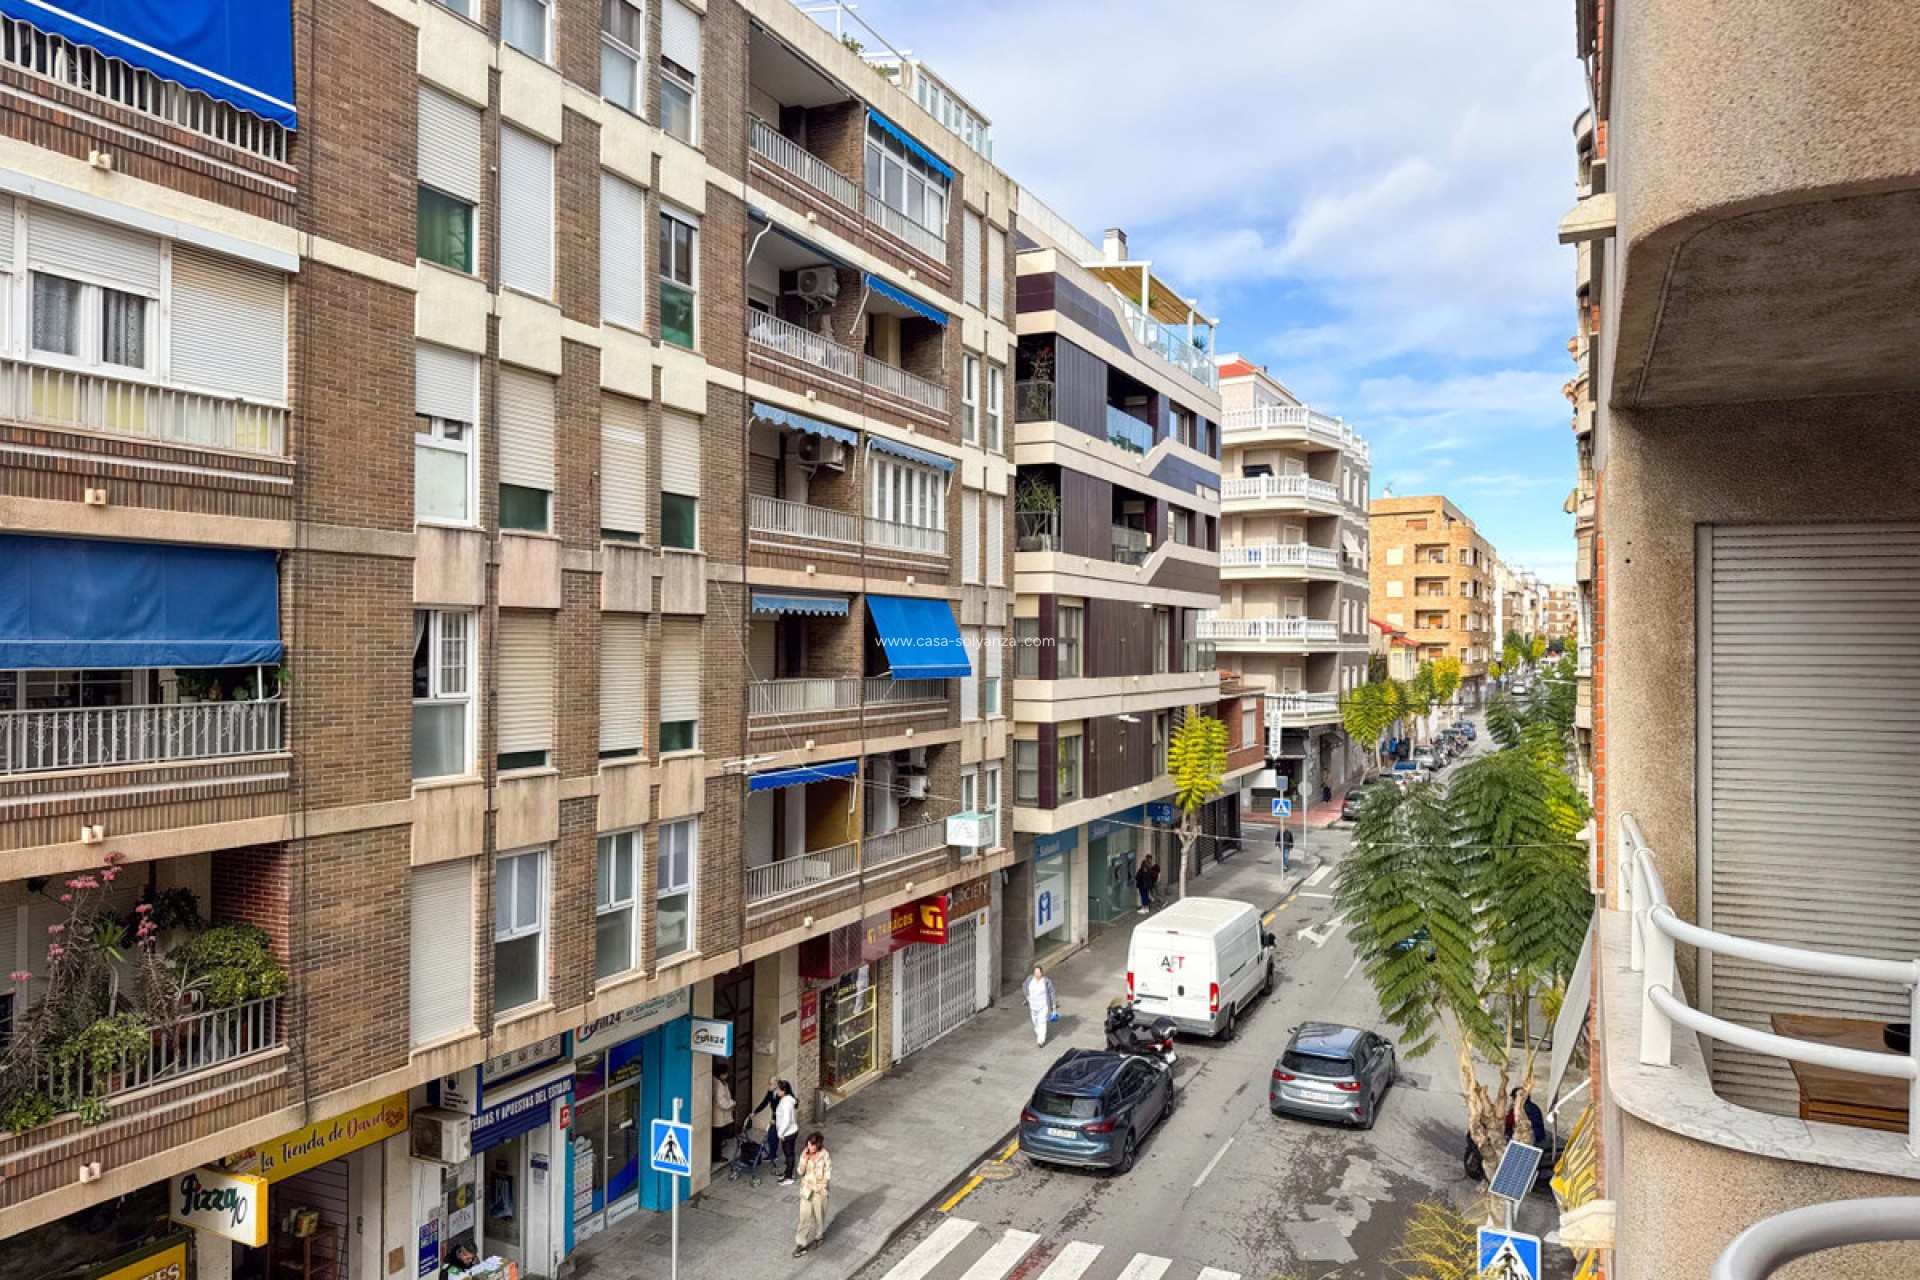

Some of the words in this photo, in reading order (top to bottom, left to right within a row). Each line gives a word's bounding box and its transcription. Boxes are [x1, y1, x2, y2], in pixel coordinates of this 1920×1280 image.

[260, 1152, 275, 1174] La
[281, 1128, 325, 1163] Tienda
[328, 1121, 344, 1143] de
[181, 1173, 237, 1215] Pizza
